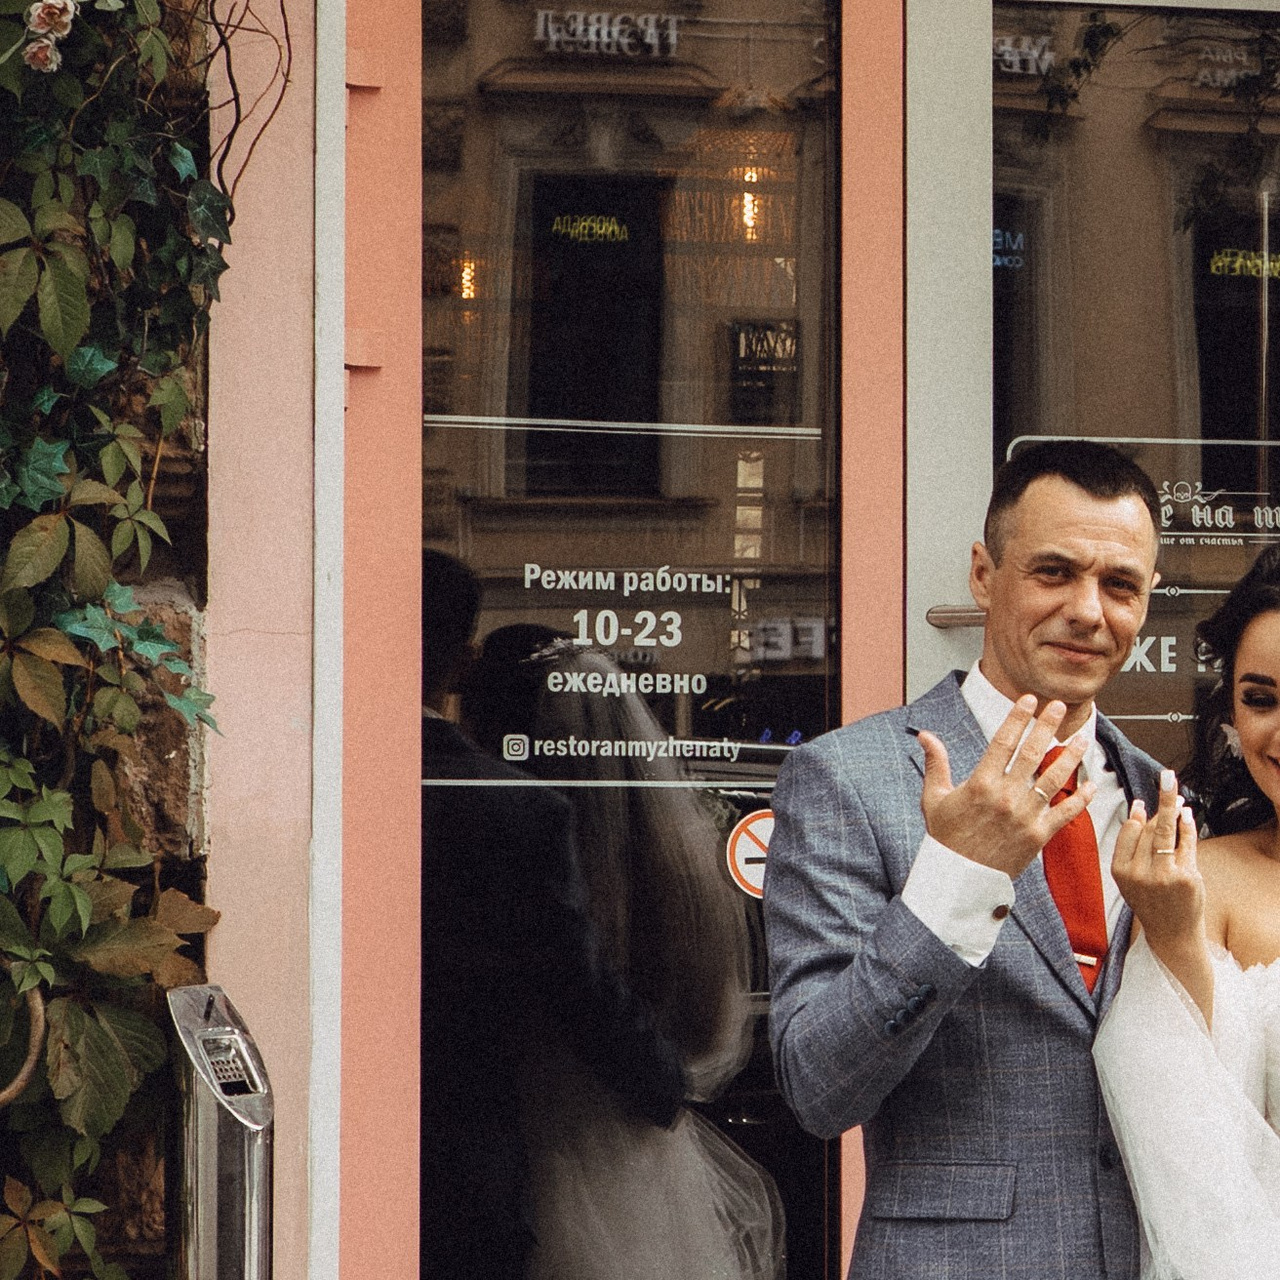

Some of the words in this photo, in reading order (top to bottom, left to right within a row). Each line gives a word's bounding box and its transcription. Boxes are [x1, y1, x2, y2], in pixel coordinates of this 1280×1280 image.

[1190, 504, 1236, 528] на
[523, 563, 616, 591] Режим
[622, 565, 732, 597] работы:
[571, 609, 682, 648] 10-23
[547, 670, 708, 698] ежедневно
[533, 735, 742, 762] restoranmyzhenaty
